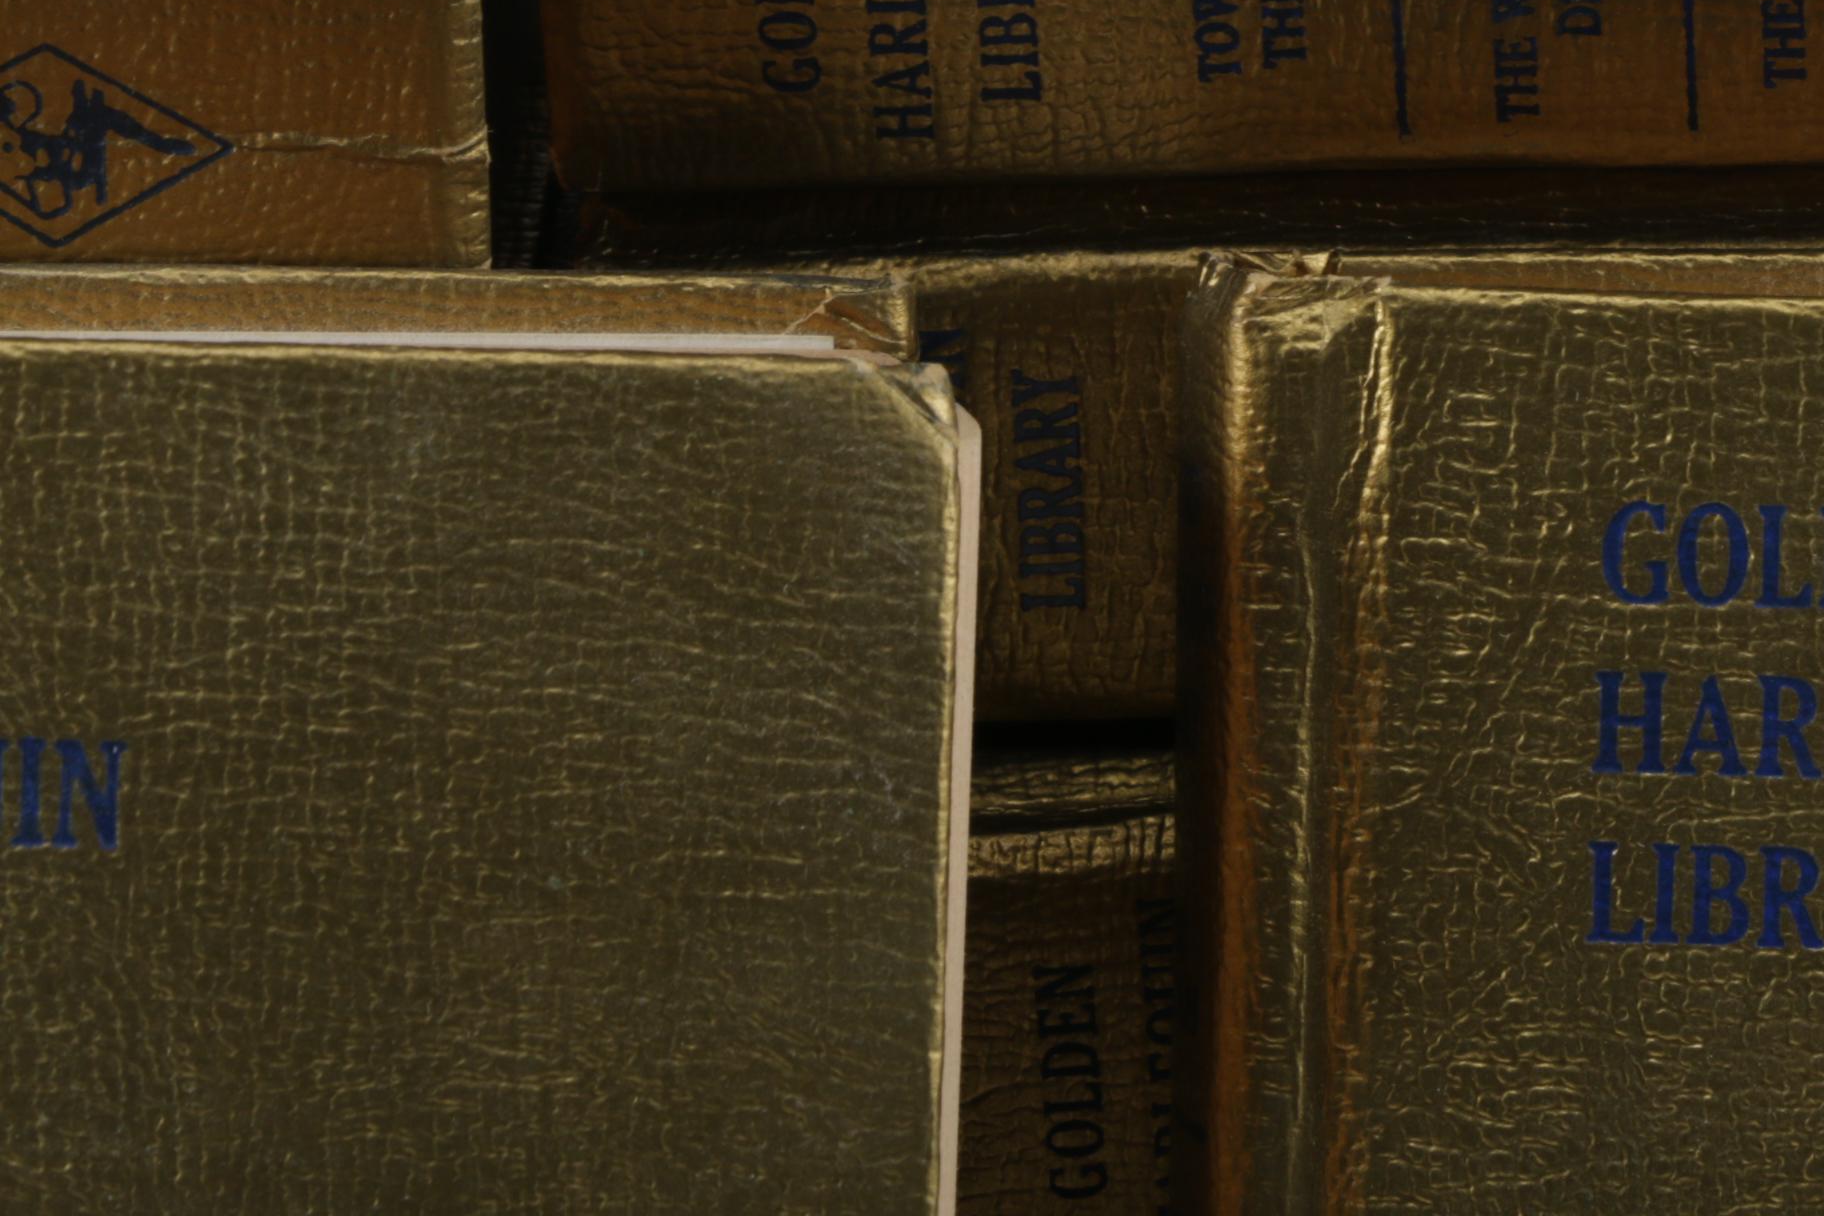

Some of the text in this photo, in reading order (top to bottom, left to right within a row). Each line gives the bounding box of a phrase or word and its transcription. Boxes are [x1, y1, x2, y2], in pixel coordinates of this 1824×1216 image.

[1494, 37, 1540, 124] THE
[1011, 368, 1090, 612] LIBRARY
[1034, 964, 1108, 1199] GOLDEN
